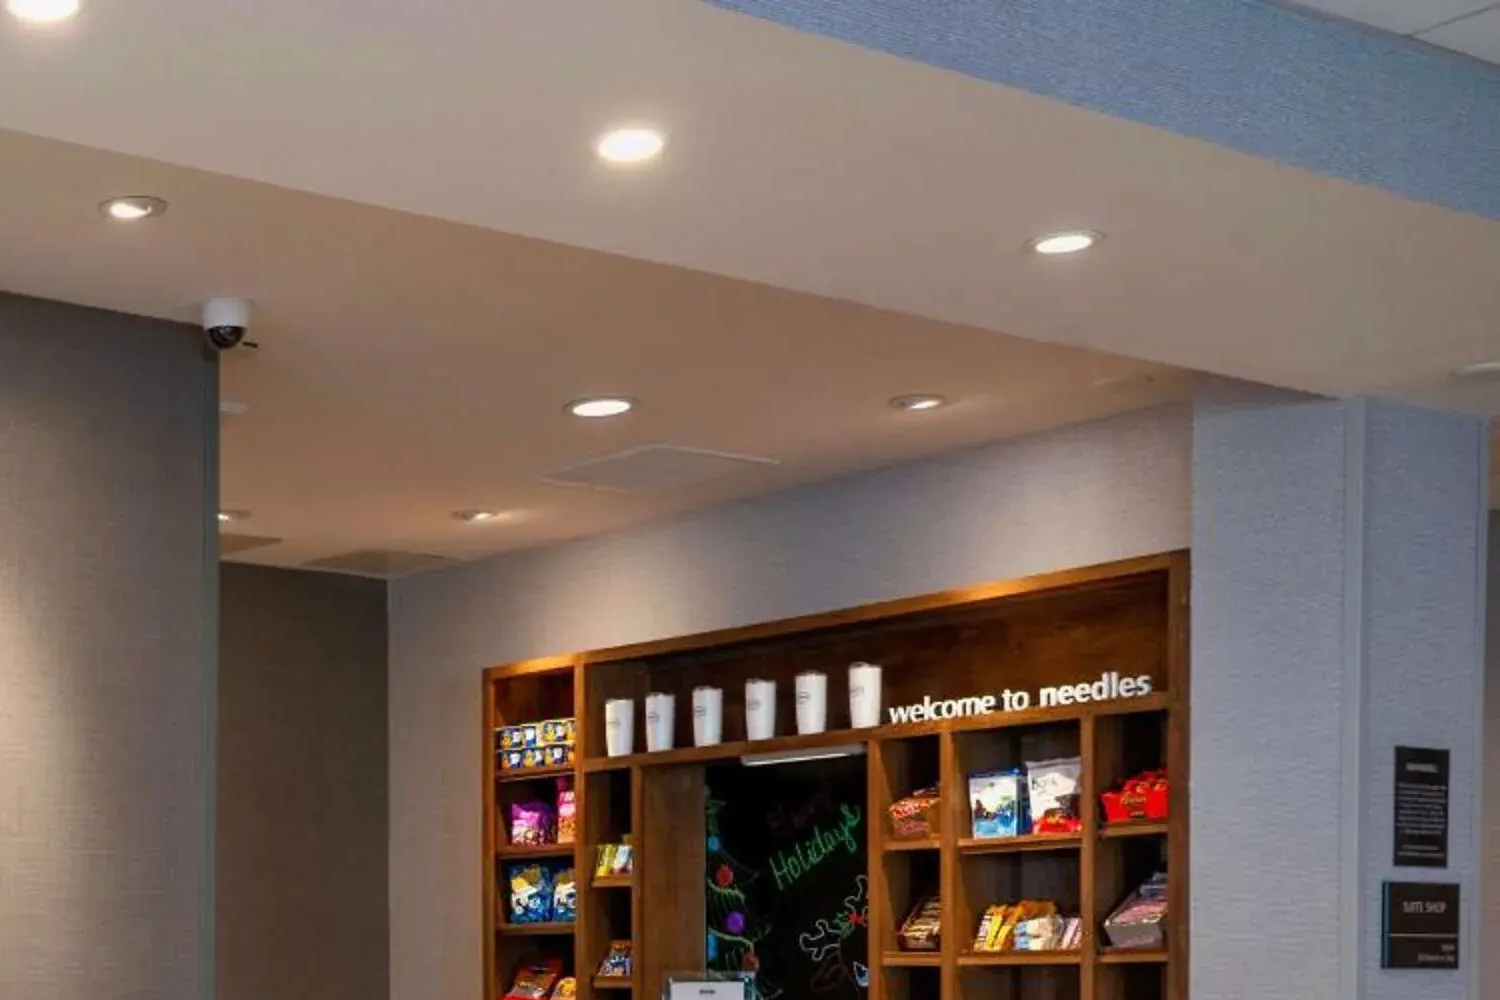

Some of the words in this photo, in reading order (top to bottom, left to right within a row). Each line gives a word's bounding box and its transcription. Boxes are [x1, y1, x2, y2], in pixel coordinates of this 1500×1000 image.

[888, 697, 993, 725] welcome
[1002, 688, 1030, 712] to
[1038, 671, 1153, 707] needles
